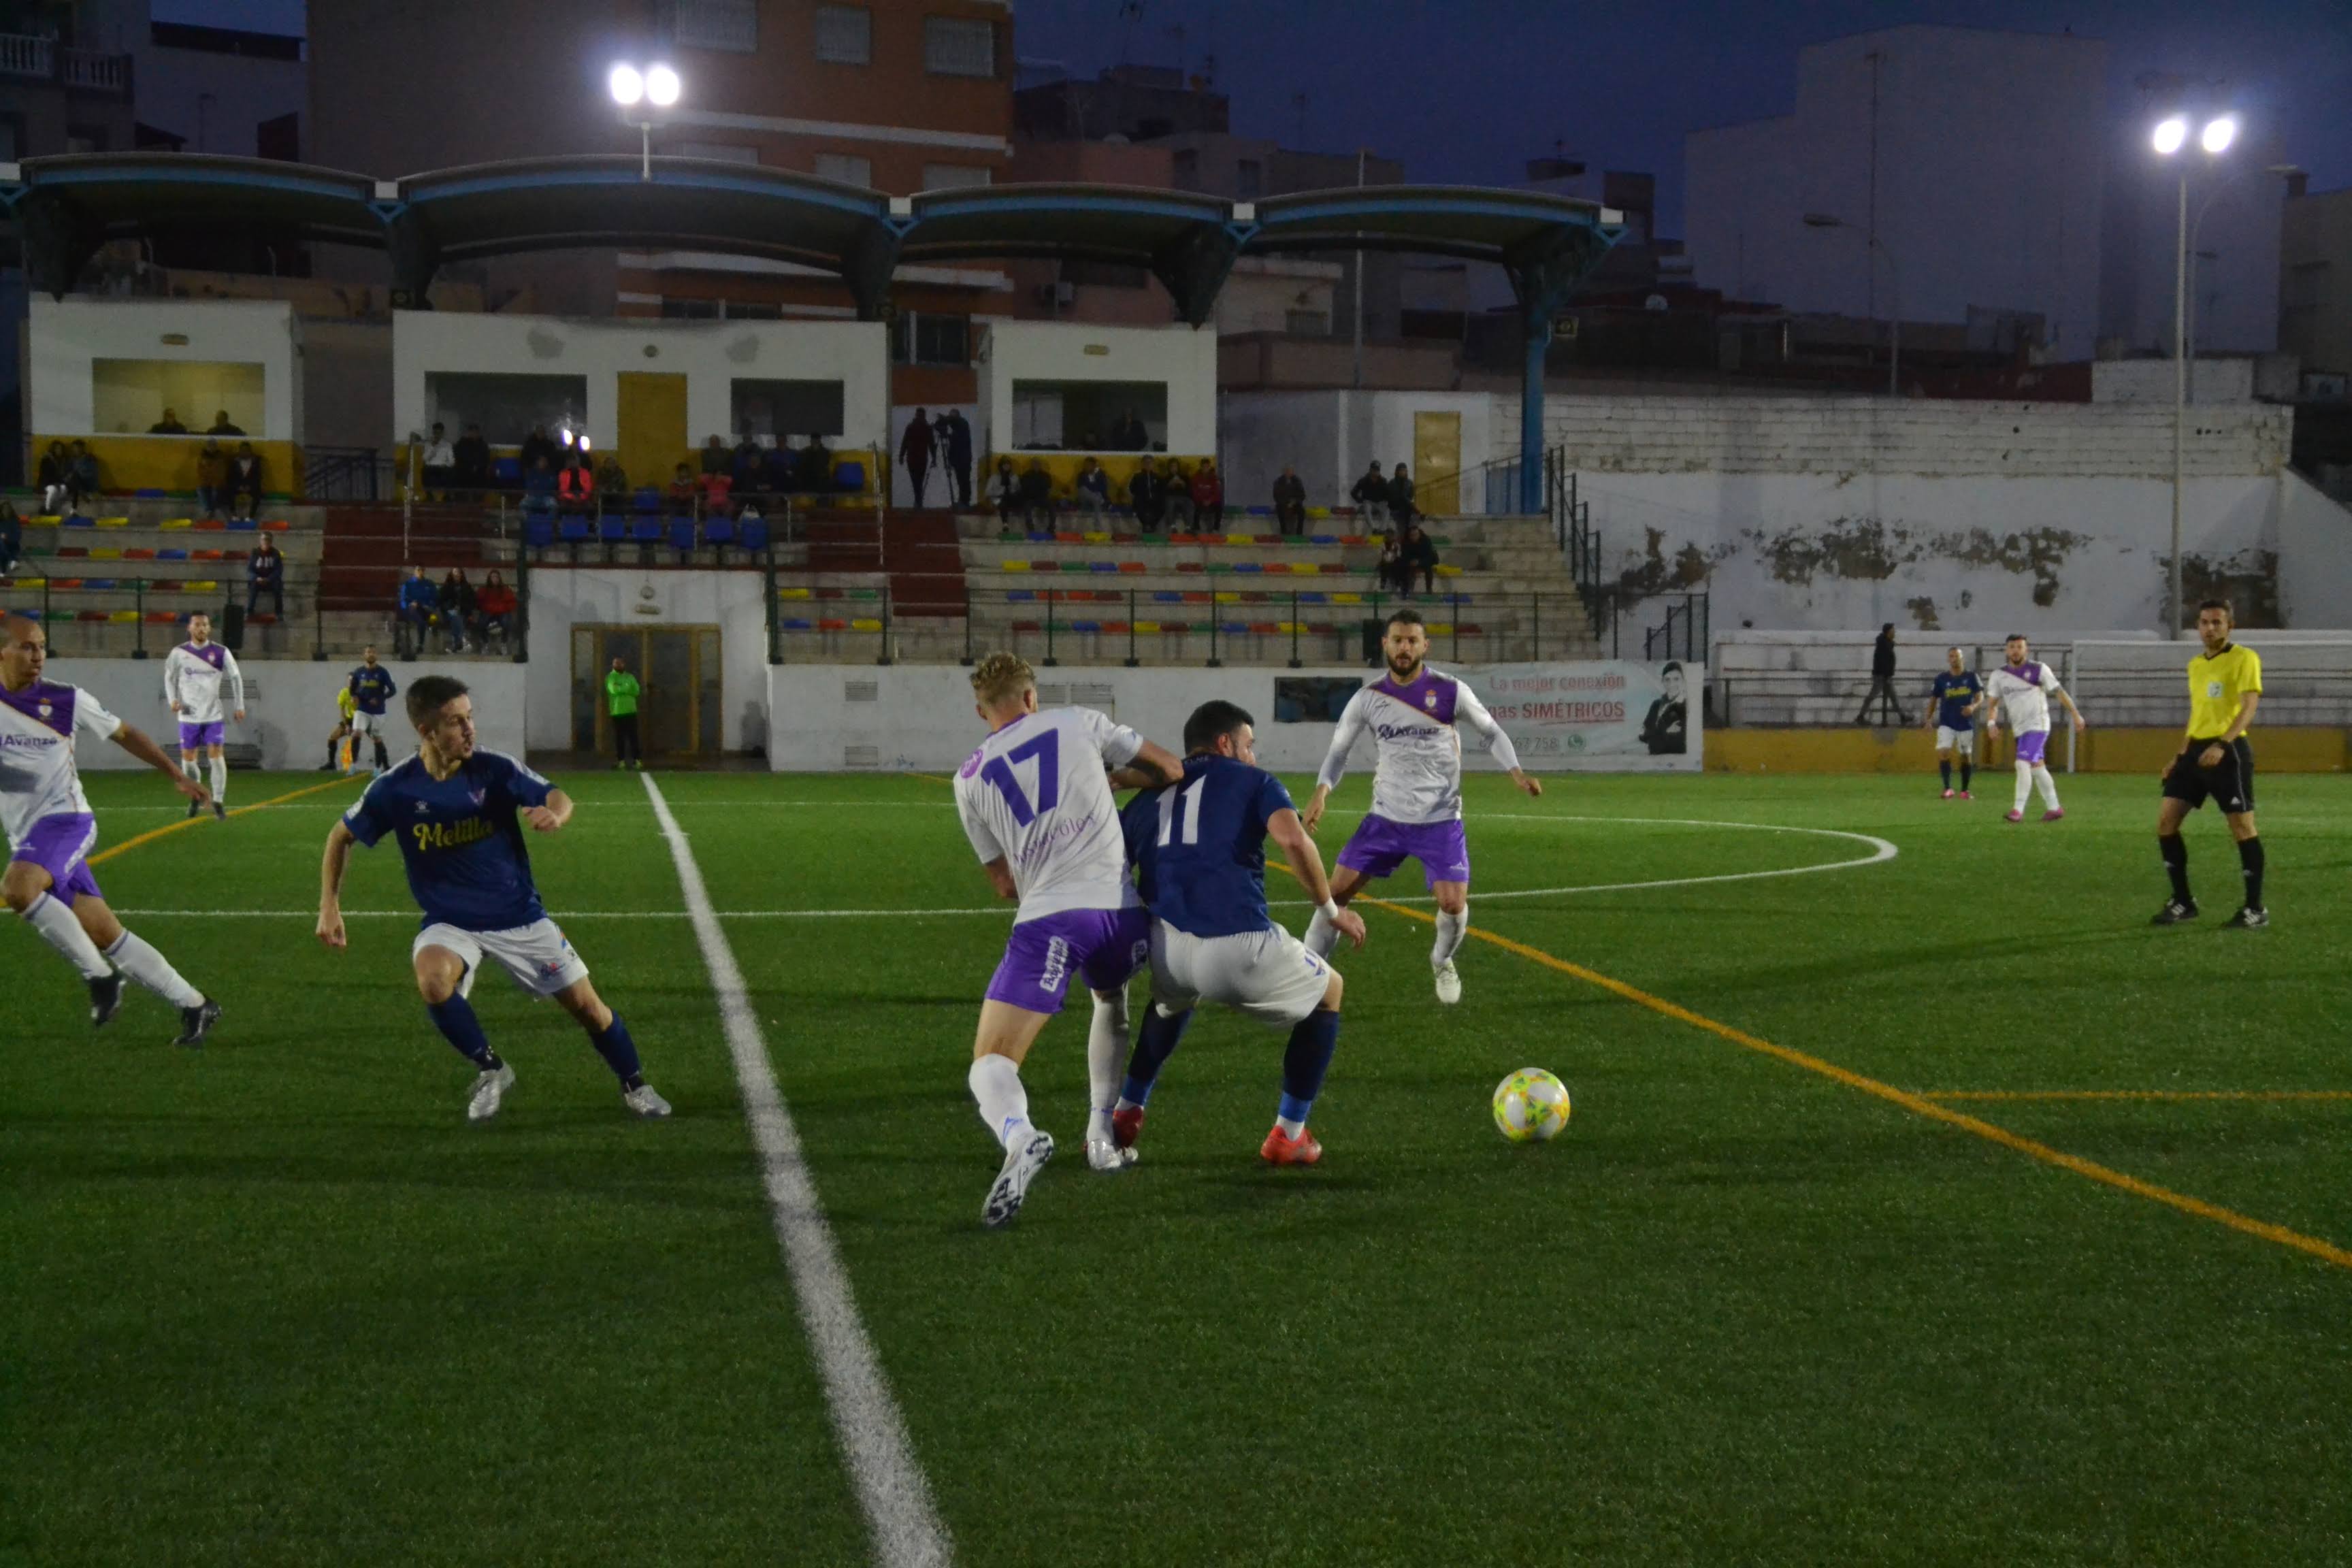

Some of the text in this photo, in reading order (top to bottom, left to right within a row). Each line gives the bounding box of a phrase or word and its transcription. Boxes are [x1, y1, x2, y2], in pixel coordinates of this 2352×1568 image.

[1513, 677, 1556, 692] mejor
[1522, 698, 1625, 718] SIMÉTRICOS
[981, 728, 1058, 828] 17
[1156, 774, 1207, 847] 11
[412, 815, 495, 852] Melilla
